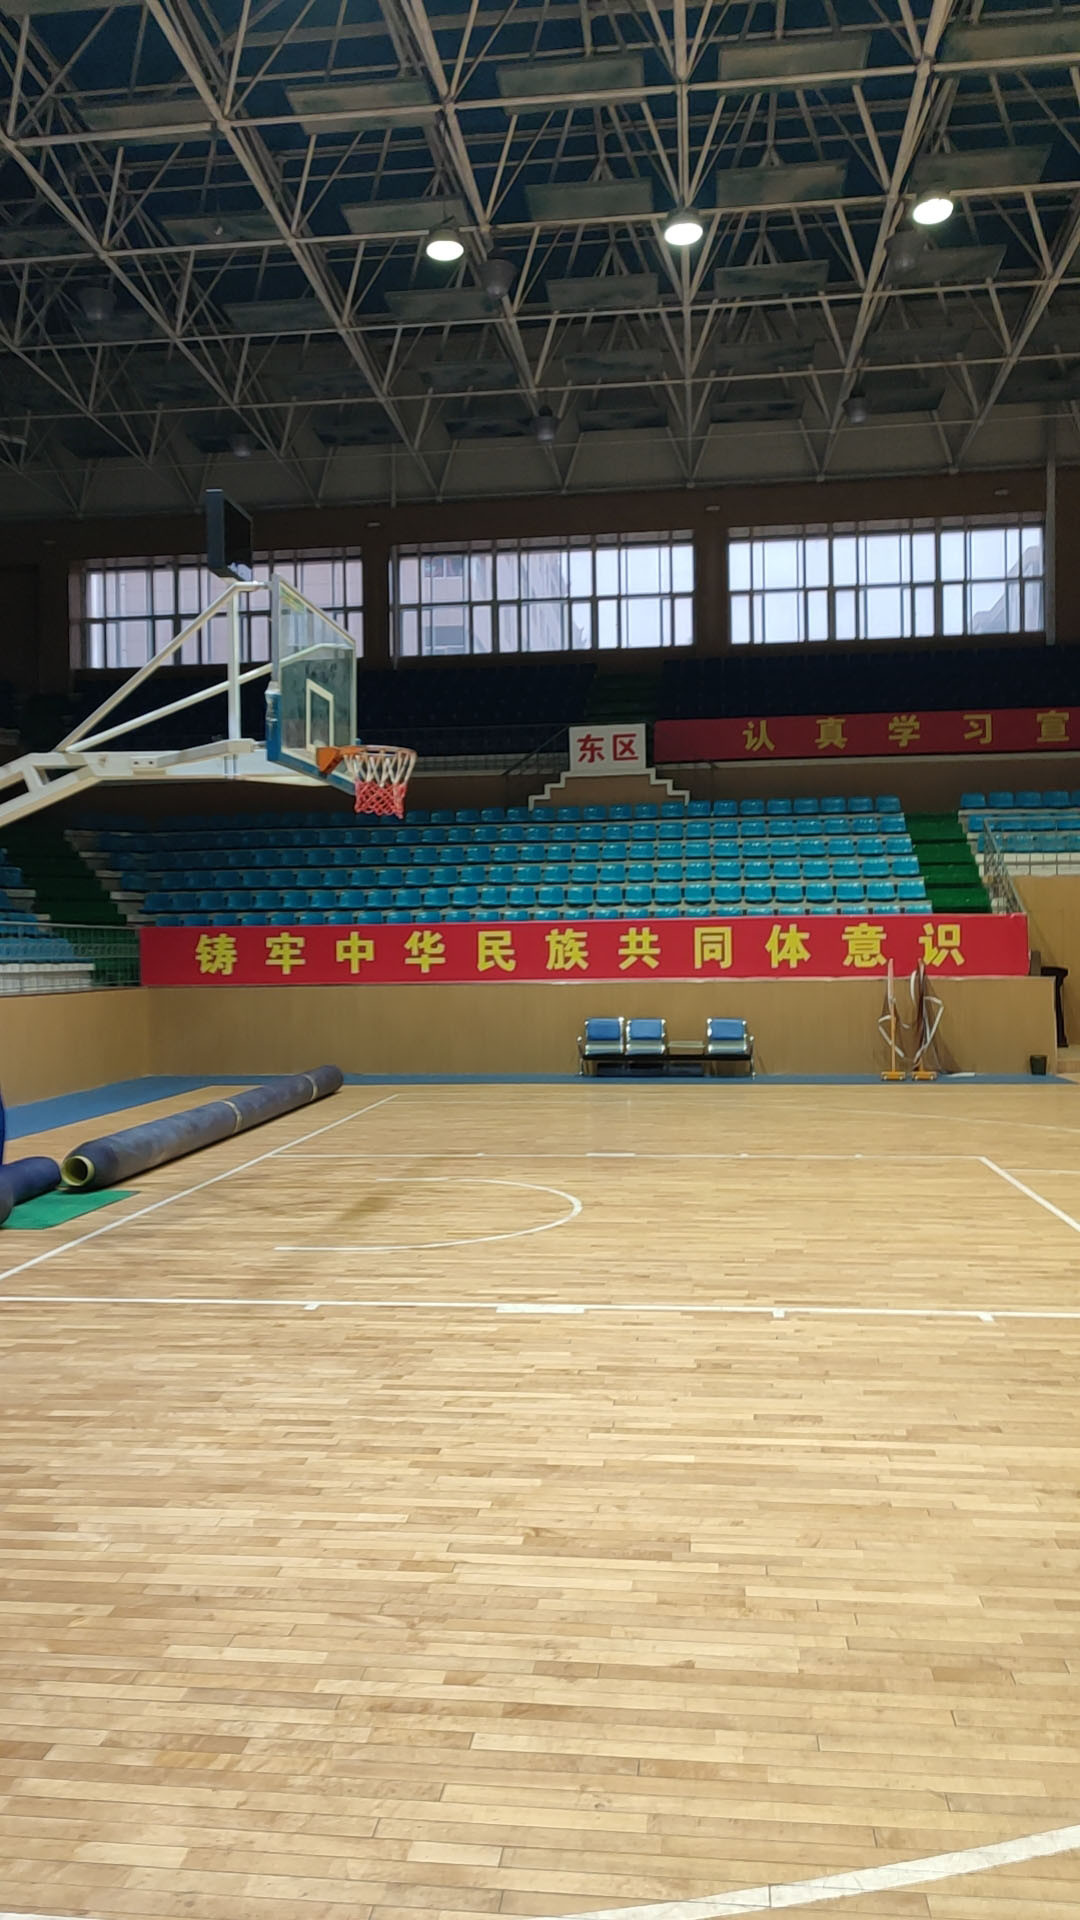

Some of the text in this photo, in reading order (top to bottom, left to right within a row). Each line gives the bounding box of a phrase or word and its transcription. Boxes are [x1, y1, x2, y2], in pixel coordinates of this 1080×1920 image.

[577, 733, 639, 763] 东区
[743, 711, 1070, 752] 认真学习宣
[195, 922, 965, 975] 铸牢中华民族共同体意识
